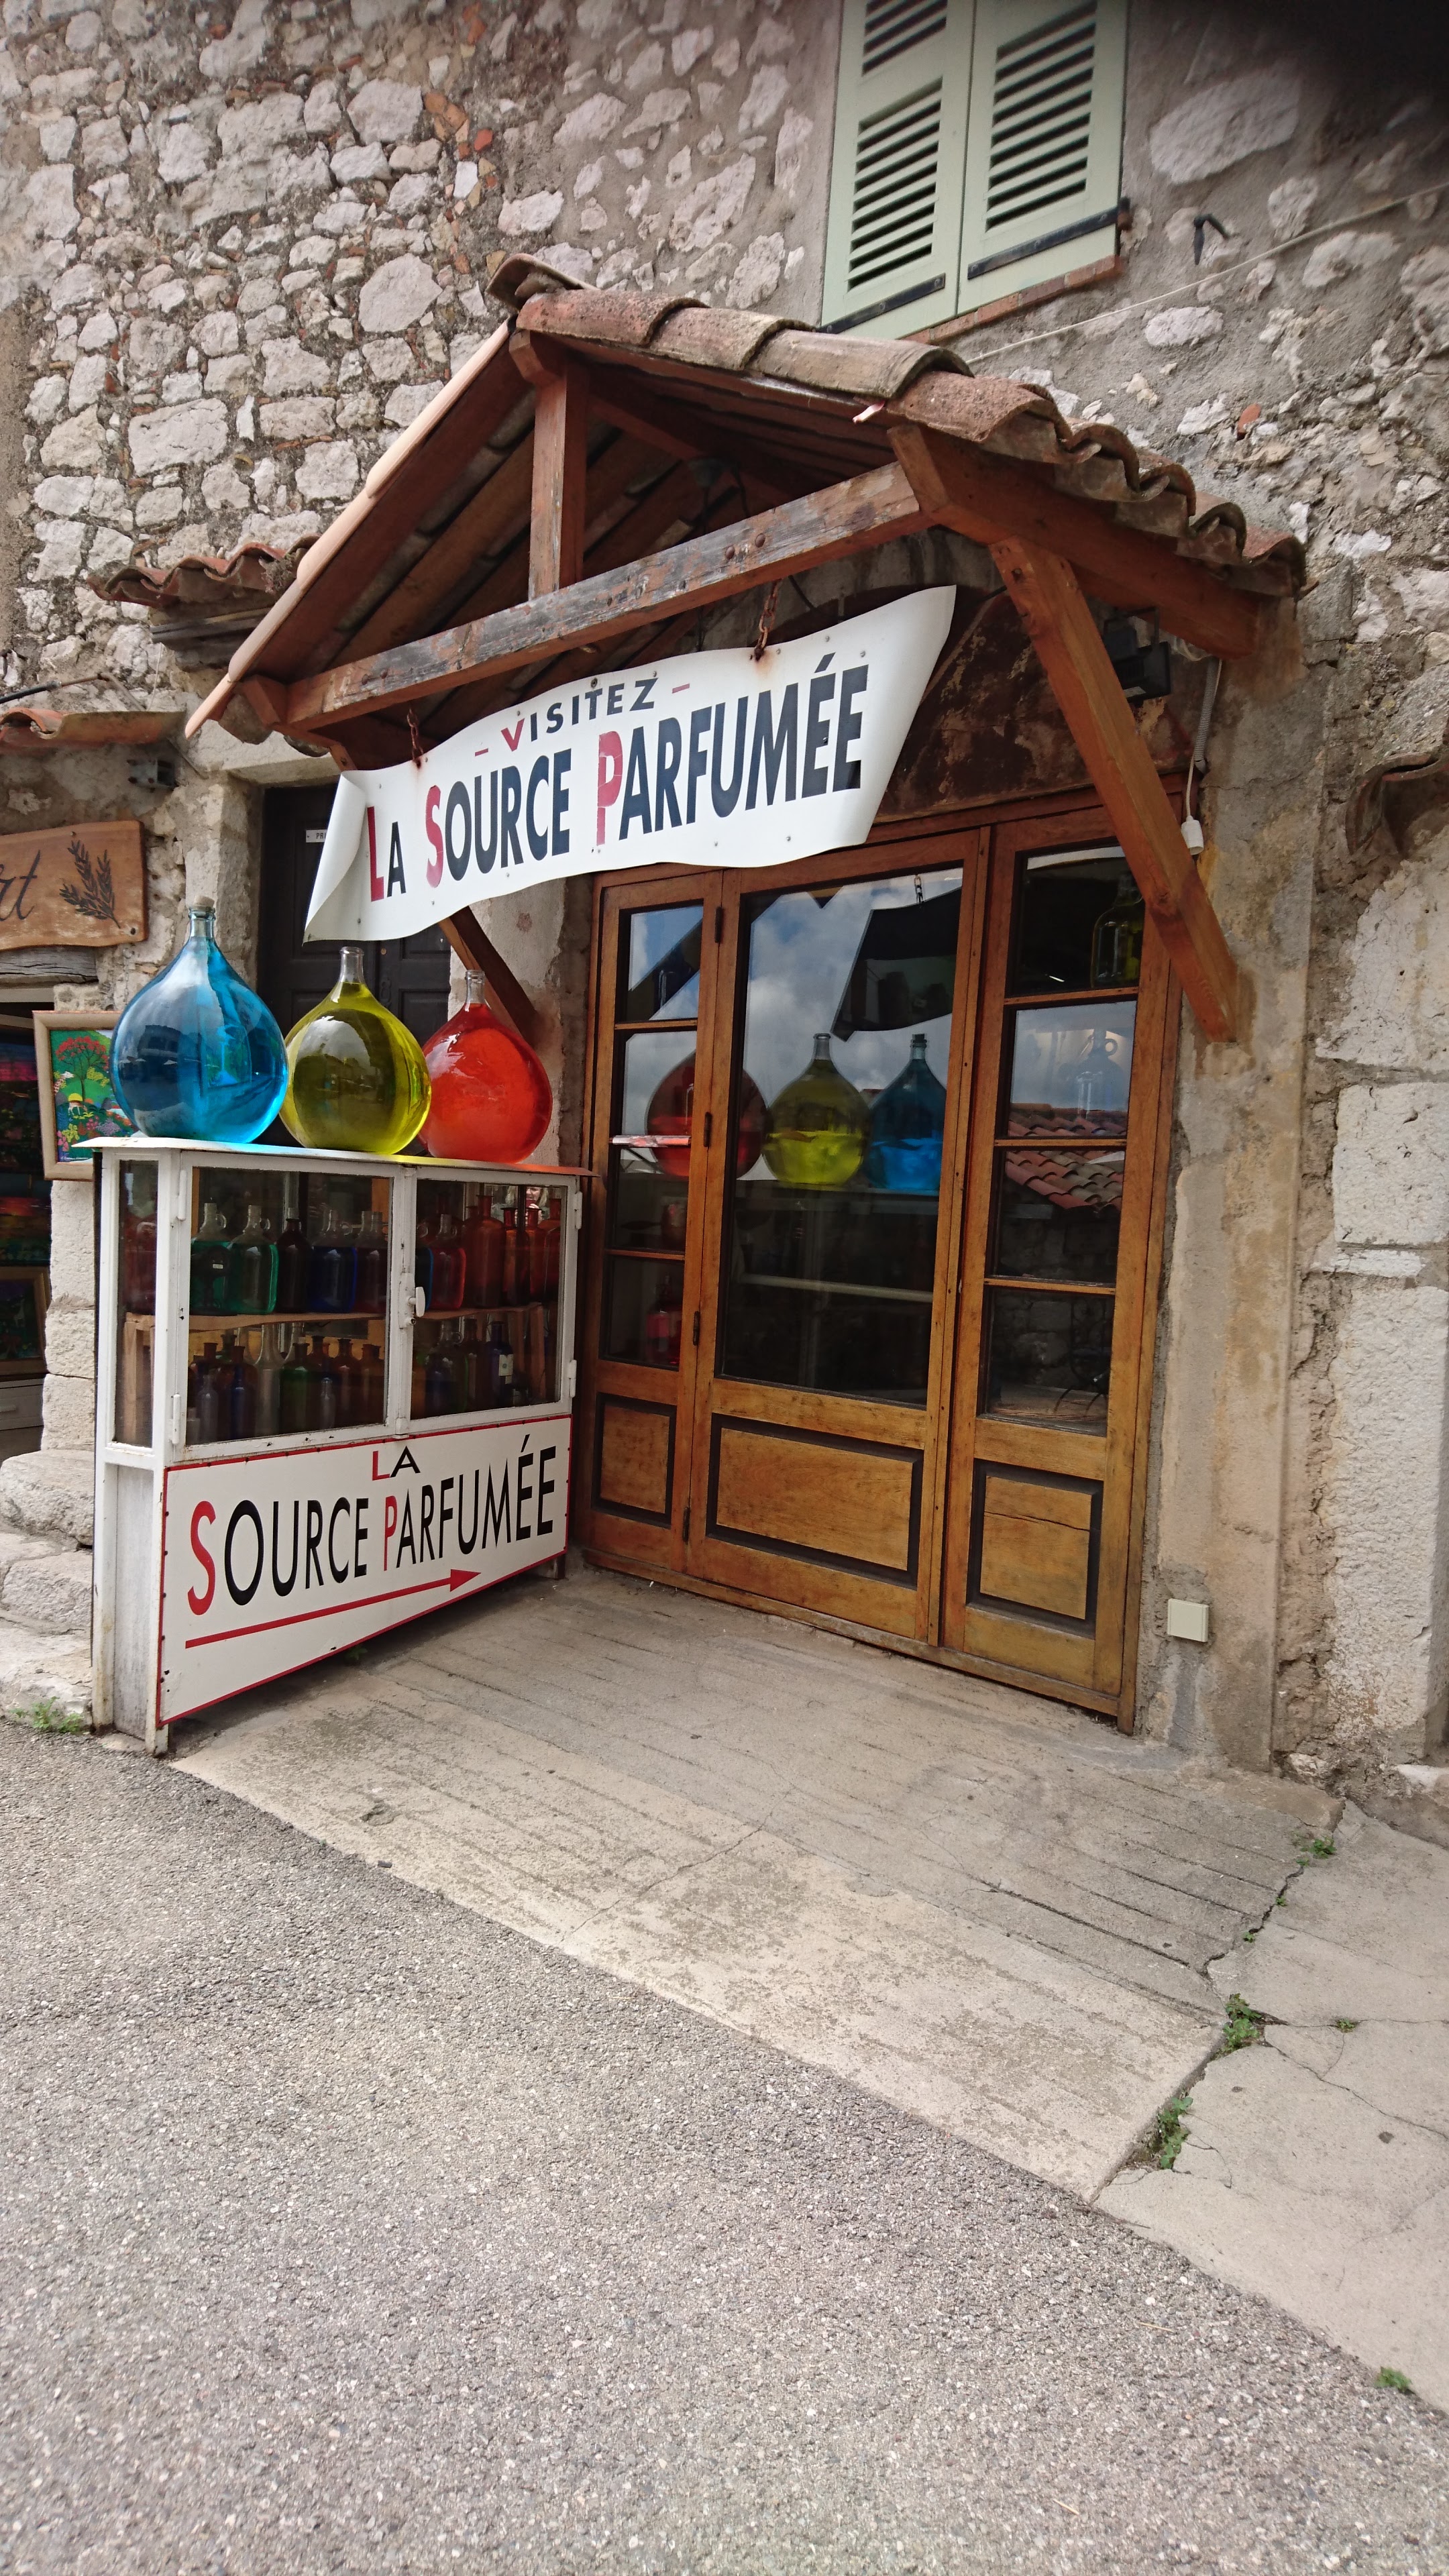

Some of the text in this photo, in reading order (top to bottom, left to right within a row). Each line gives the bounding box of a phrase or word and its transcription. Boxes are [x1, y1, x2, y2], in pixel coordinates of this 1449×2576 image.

[366, 652, 869, 902] LA SOURCE PARFUMÉE
[501, 677, 659, 753] VISITEZ
[187, 1434, 556, 1615] SOURCE PARFUMÉE
[372, 1445, 421, 1481] LA
